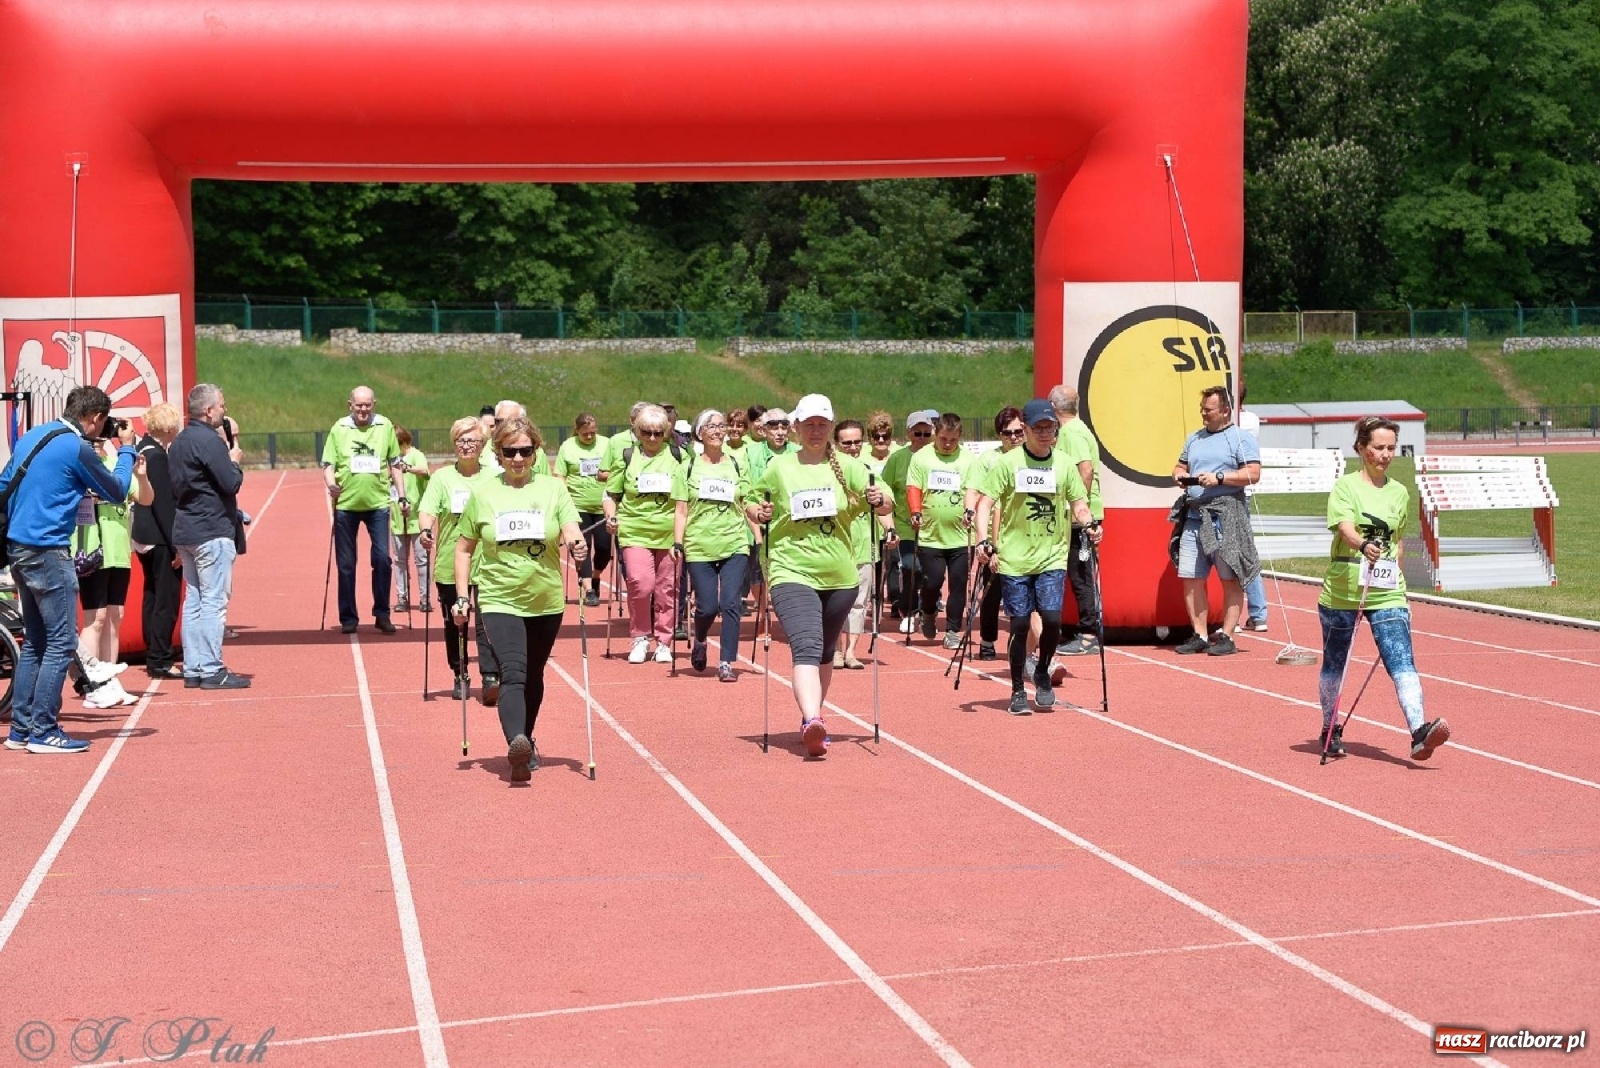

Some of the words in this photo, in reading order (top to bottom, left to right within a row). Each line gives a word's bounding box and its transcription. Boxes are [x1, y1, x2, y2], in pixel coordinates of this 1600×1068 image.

[1026, 475, 1045, 485] 026
[802, 498, 823, 509] 075
[509, 520, 531, 531] 034
[1373, 568, 1392, 579] 027
